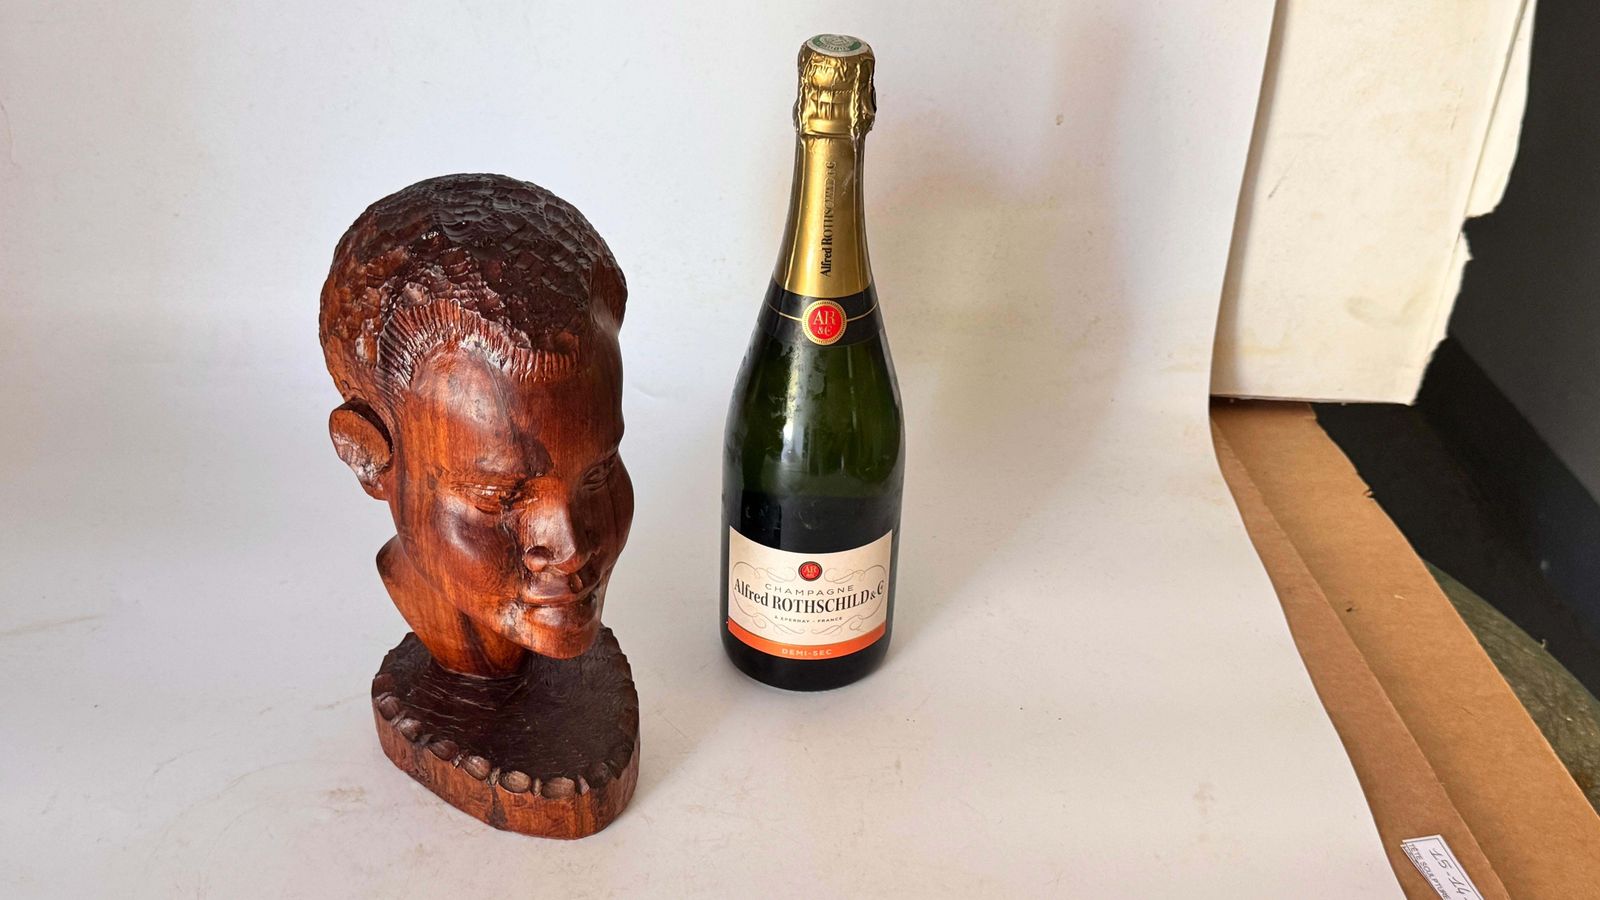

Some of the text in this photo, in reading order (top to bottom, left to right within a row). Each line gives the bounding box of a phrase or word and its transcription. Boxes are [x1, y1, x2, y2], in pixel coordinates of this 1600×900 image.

[820, 247, 833, 277] Alfred
[813, 311, 836, 326] AR
[734, 578, 768, 607] Alfred
[772, 589, 870, 614] ROTHSCHILD
[765, 583, 854, 596] CHAMPAGNE
[782, 648, 832, 657] DEMI-SEC
